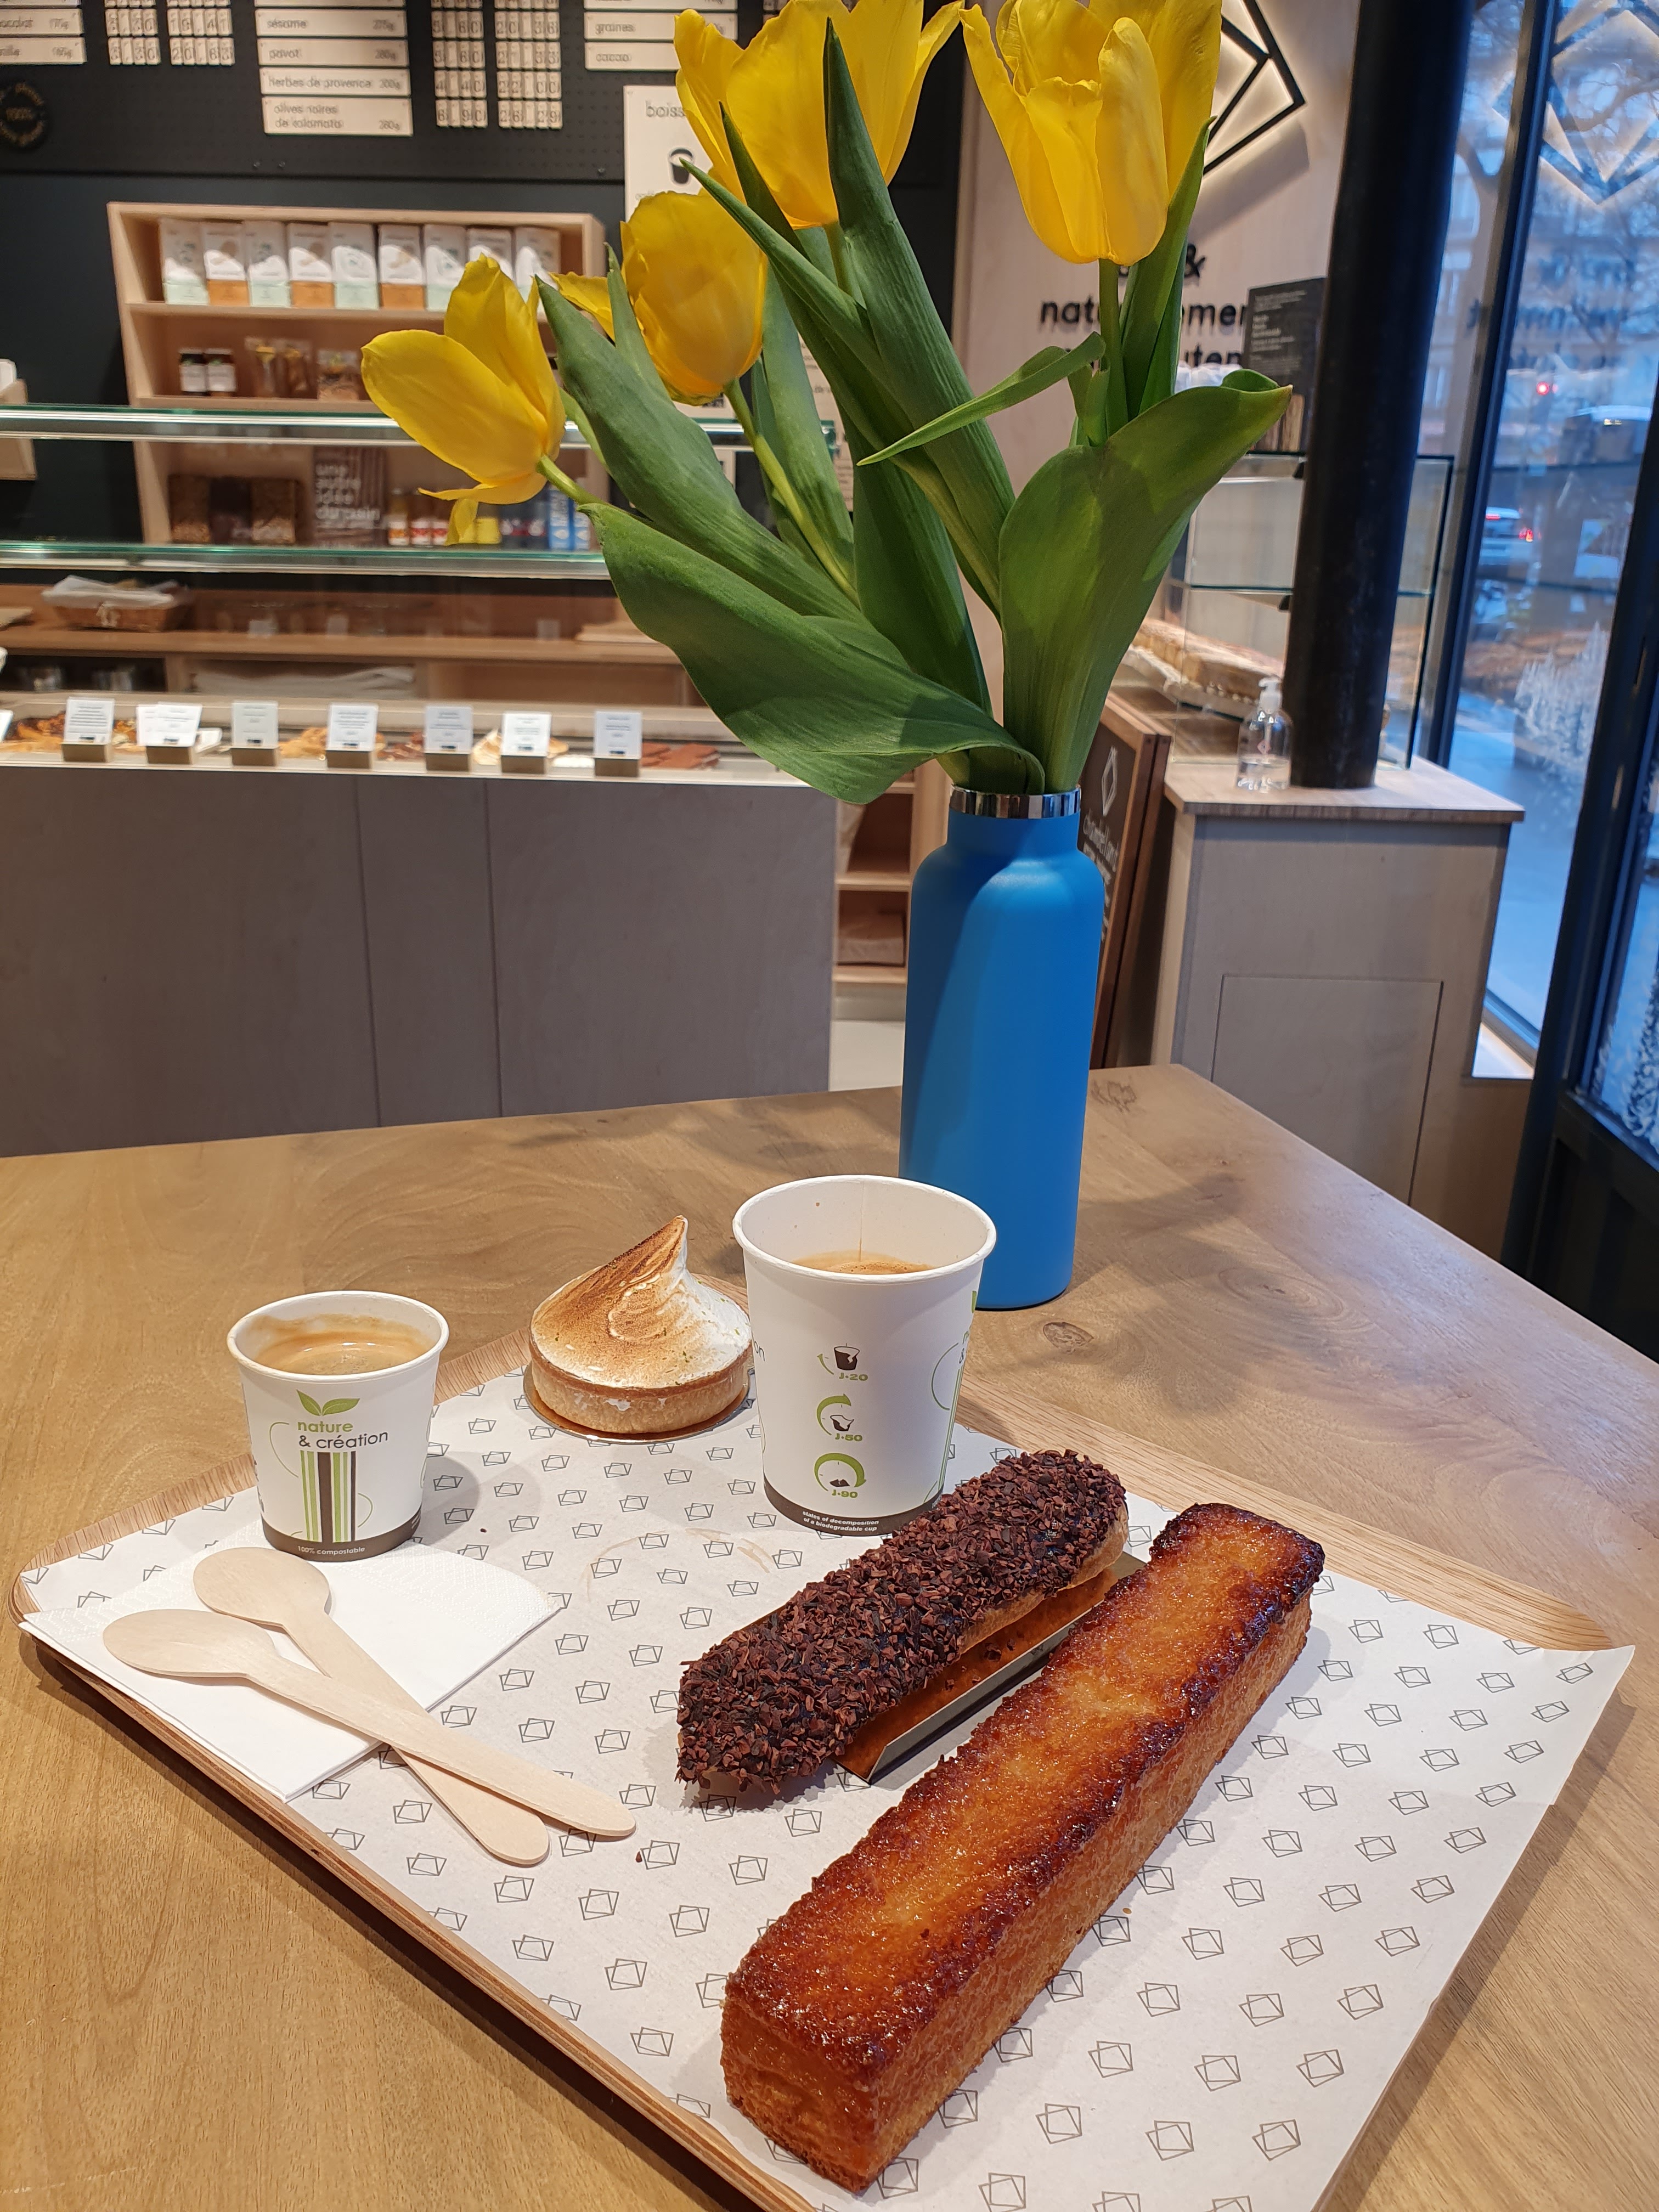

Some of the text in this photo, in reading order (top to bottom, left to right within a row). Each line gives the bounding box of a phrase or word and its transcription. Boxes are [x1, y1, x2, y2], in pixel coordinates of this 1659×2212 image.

[595, 23, 635, 35] graines
[596, 53, 630, 63] cacao
[268, 76, 304, 88] herbes
[307, 76, 320, 87] de
[646, 100, 685, 118] boiss
[298, 1421, 353, 1433] nature
[299, 1432, 388, 1448] & création
[803, 1511, 821, 1520] states
[816, 1521, 863, 1531] biodegradable
[297, 1545, 366, 1556] 100% compostable
